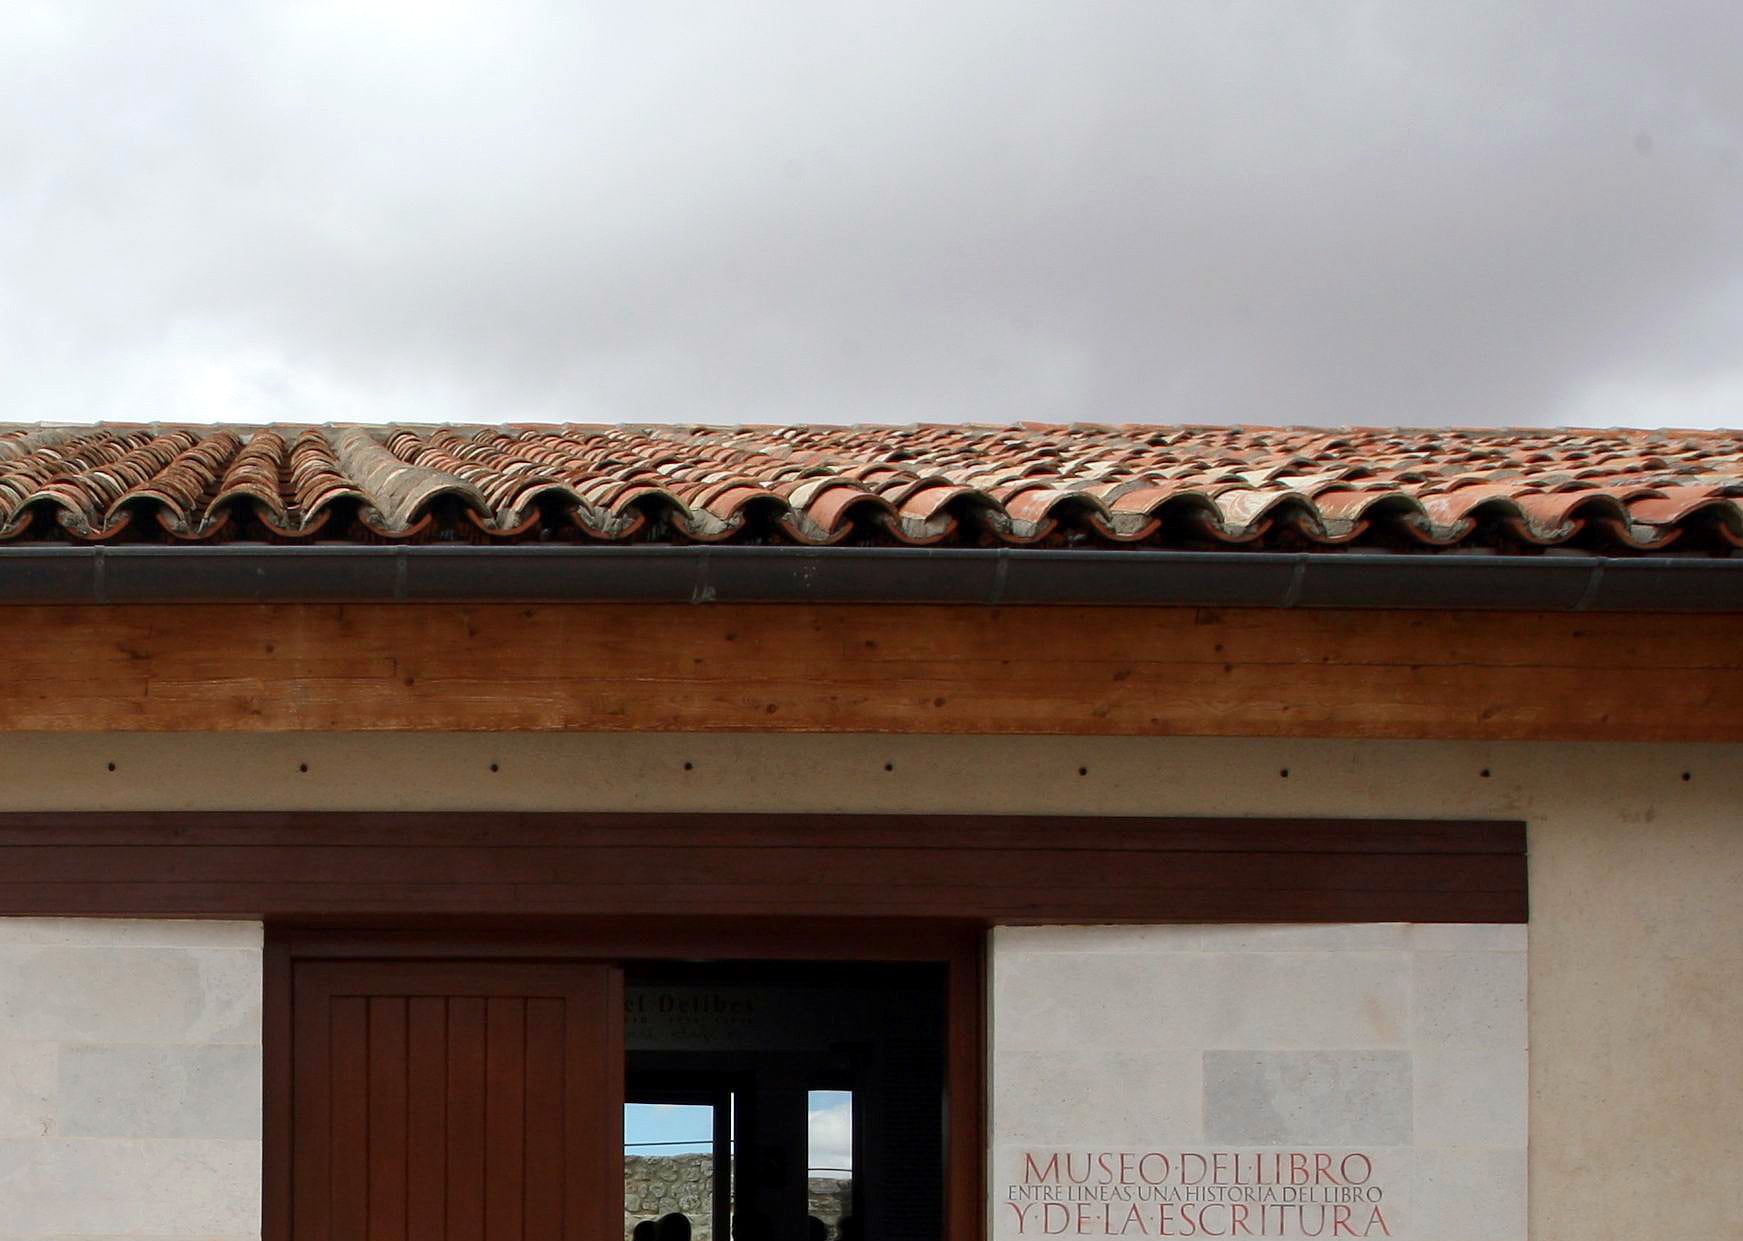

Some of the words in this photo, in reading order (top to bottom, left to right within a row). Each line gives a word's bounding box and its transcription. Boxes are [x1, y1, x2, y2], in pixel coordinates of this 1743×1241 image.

[1024, 1152, 1170, 1185] MUSEO
[1180, 1153, 1248, 1185] DEL
[1256, 1153, 1372, 1186] LIBRO
[1008, 1185, 1063, 1201] ENTRE
[1138, 1186, 1183, 1201] UNA
[1186, 1186, 1278, 1202] HISTORIA
[1283, 1186, 1320, 1203] DEL
[1324, 1186, 1383, 1203] LIBRO
[1008, 1202, 1038, 1234] Y
[1043, 1202, 1093, 1235] DE
[1103, 1202, 1149, 1235] LA
[1159, 1203, 1392, 1237] ESCRITURA
